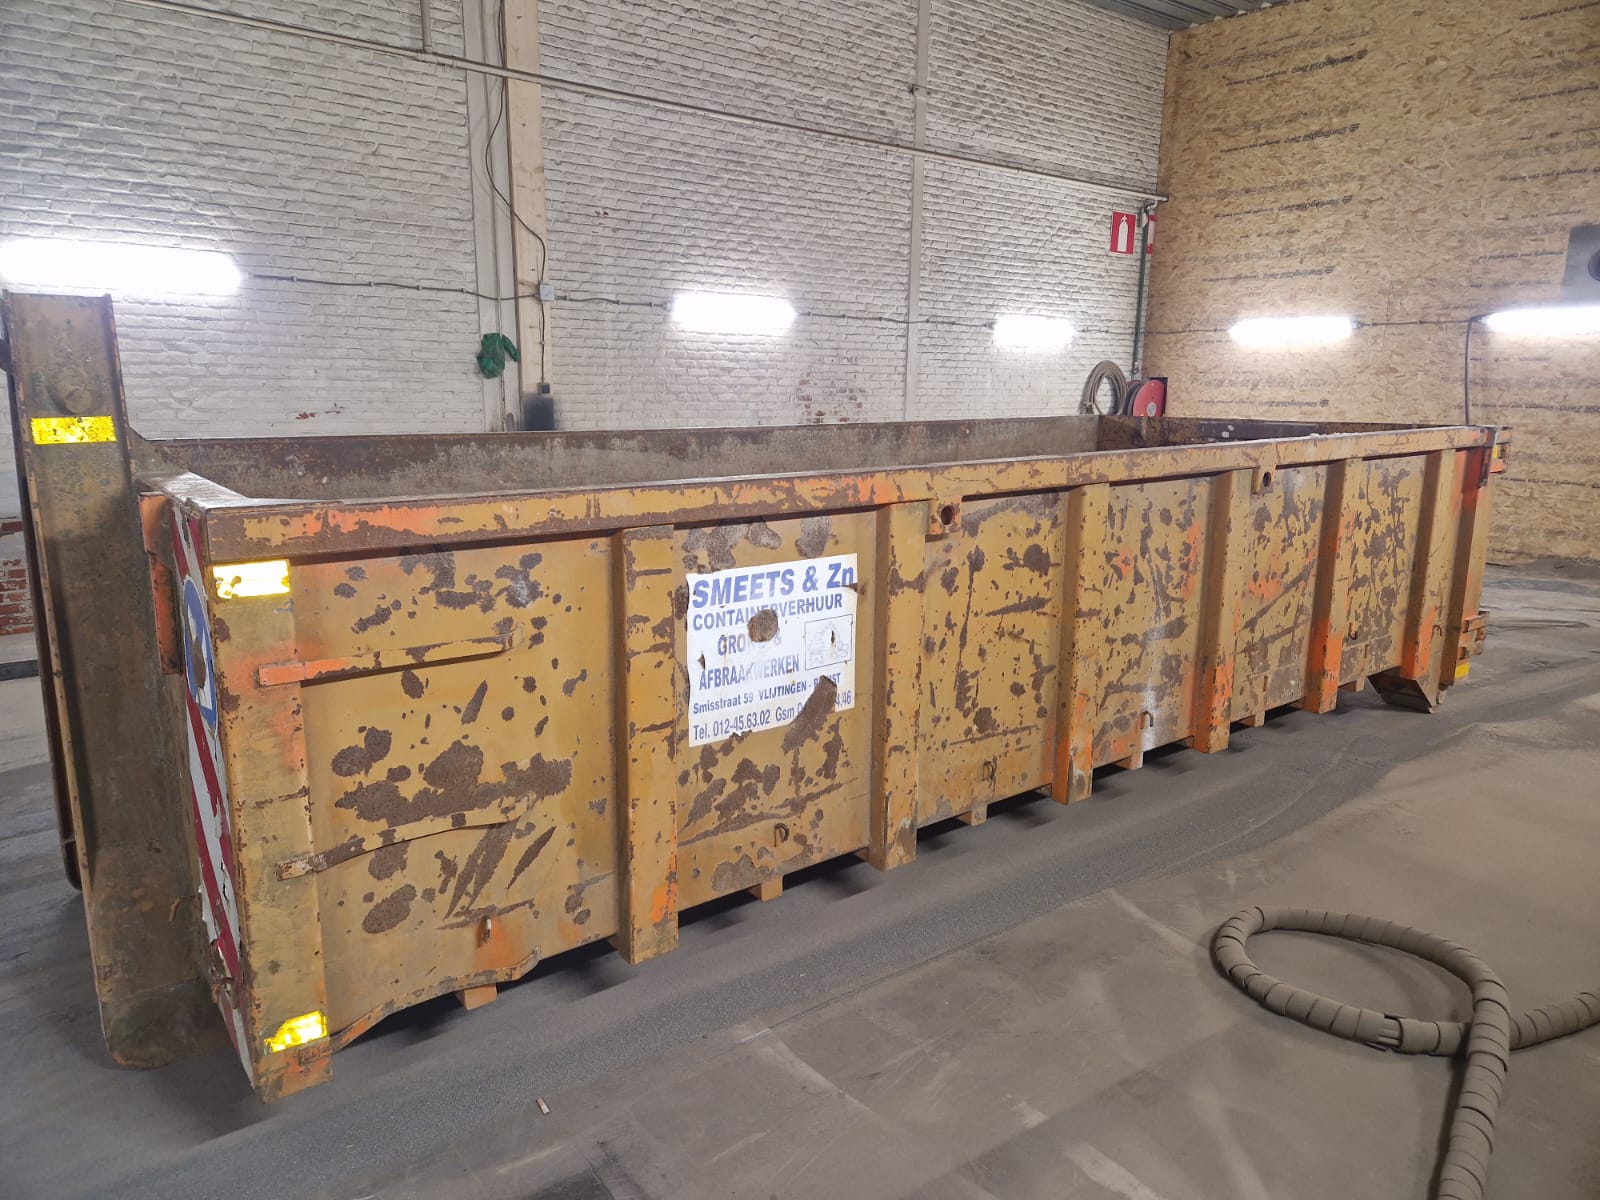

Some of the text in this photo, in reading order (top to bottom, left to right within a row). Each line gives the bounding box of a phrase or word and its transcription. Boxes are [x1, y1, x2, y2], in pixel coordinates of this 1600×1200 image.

[692, 569, 795, 608] SMEETS
[802, 565, 818, 592] &
[693, 692, 741, 714] Smisstraat
[759, 680, 807, 701] VLIJTINGEN
[693, 706, 795, 741] Tel. 012-45.63.02 Gsm
